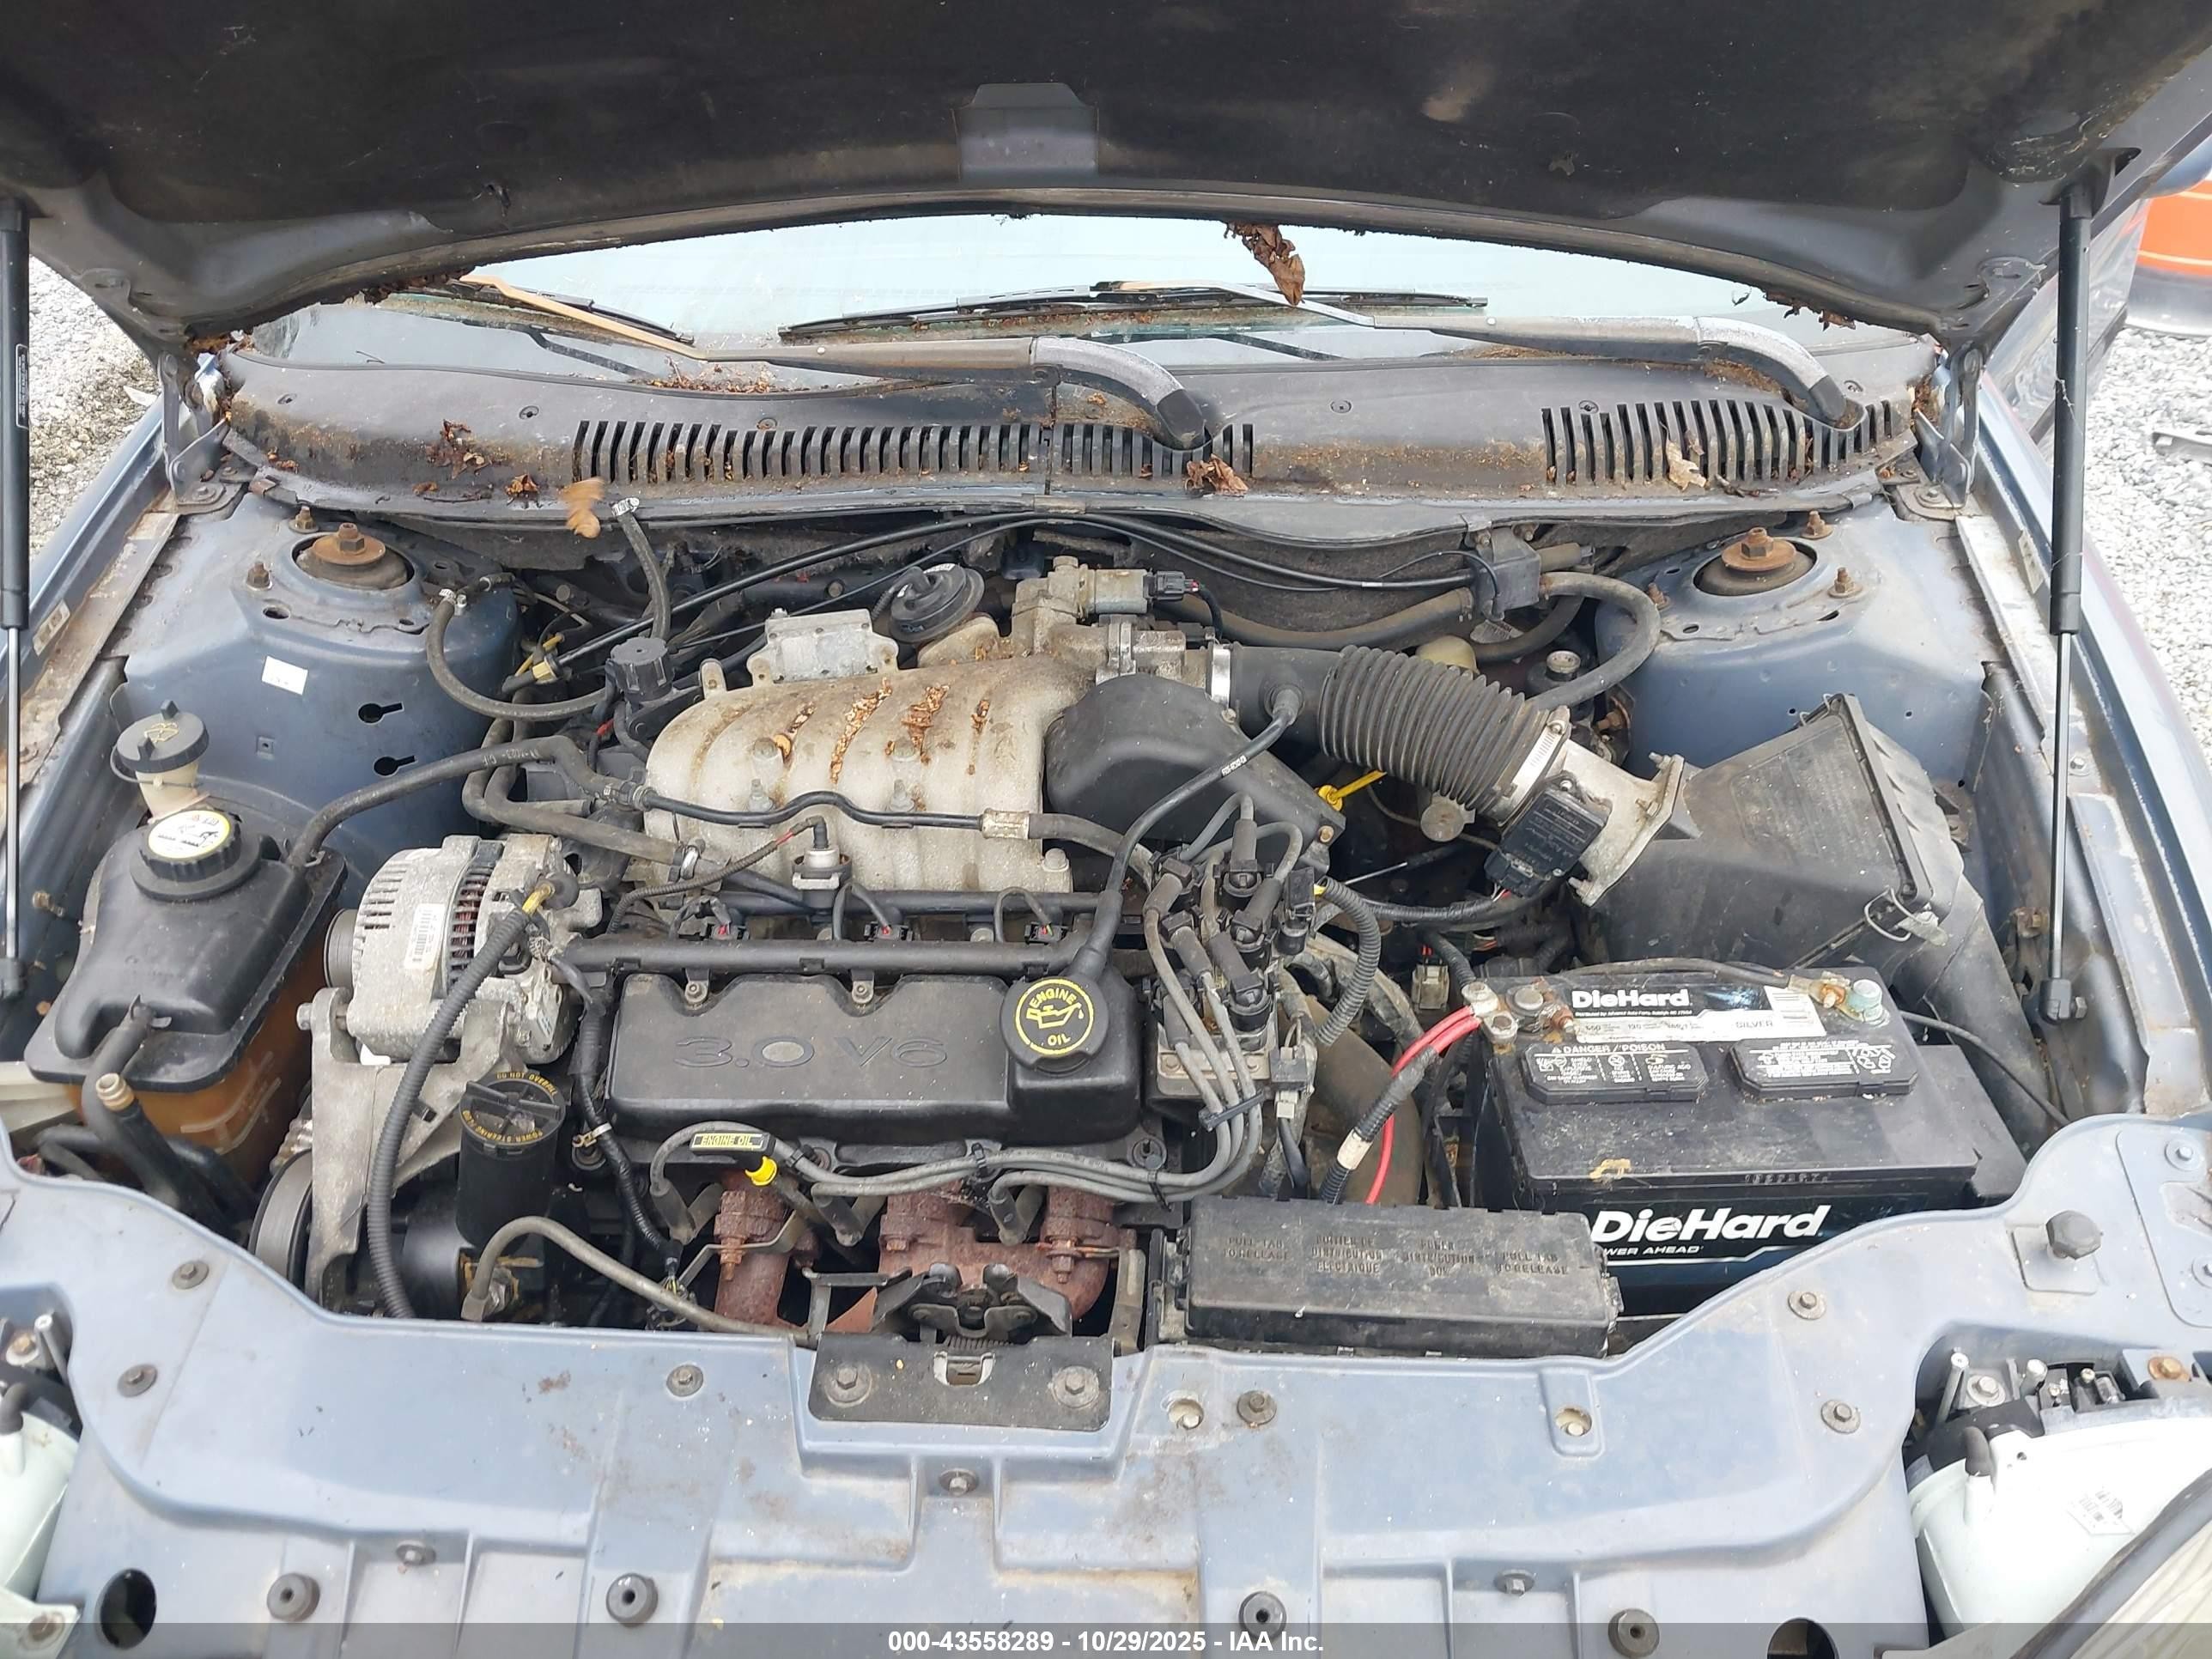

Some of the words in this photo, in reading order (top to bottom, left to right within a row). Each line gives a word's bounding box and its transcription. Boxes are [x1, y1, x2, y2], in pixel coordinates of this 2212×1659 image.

[1029, 988, 1078, 1009] ENGINE
[1571, 989, 1692, 1008] DieHard
[1048, 1034, 1071, 1046] OIL
[673, 1036, 815, 1068] 3.0
[834, 1036, 947, 1068] V6
[1564, 1044, 1610, 1053] DANGER
[701, 1135, 736, 1146] ENGINE
[738, 1134, 753, 1146] OIL
[1590, 1205, 1832, 1243] DieHard
[1642, 1245, 1697, 1255] AHEAD
